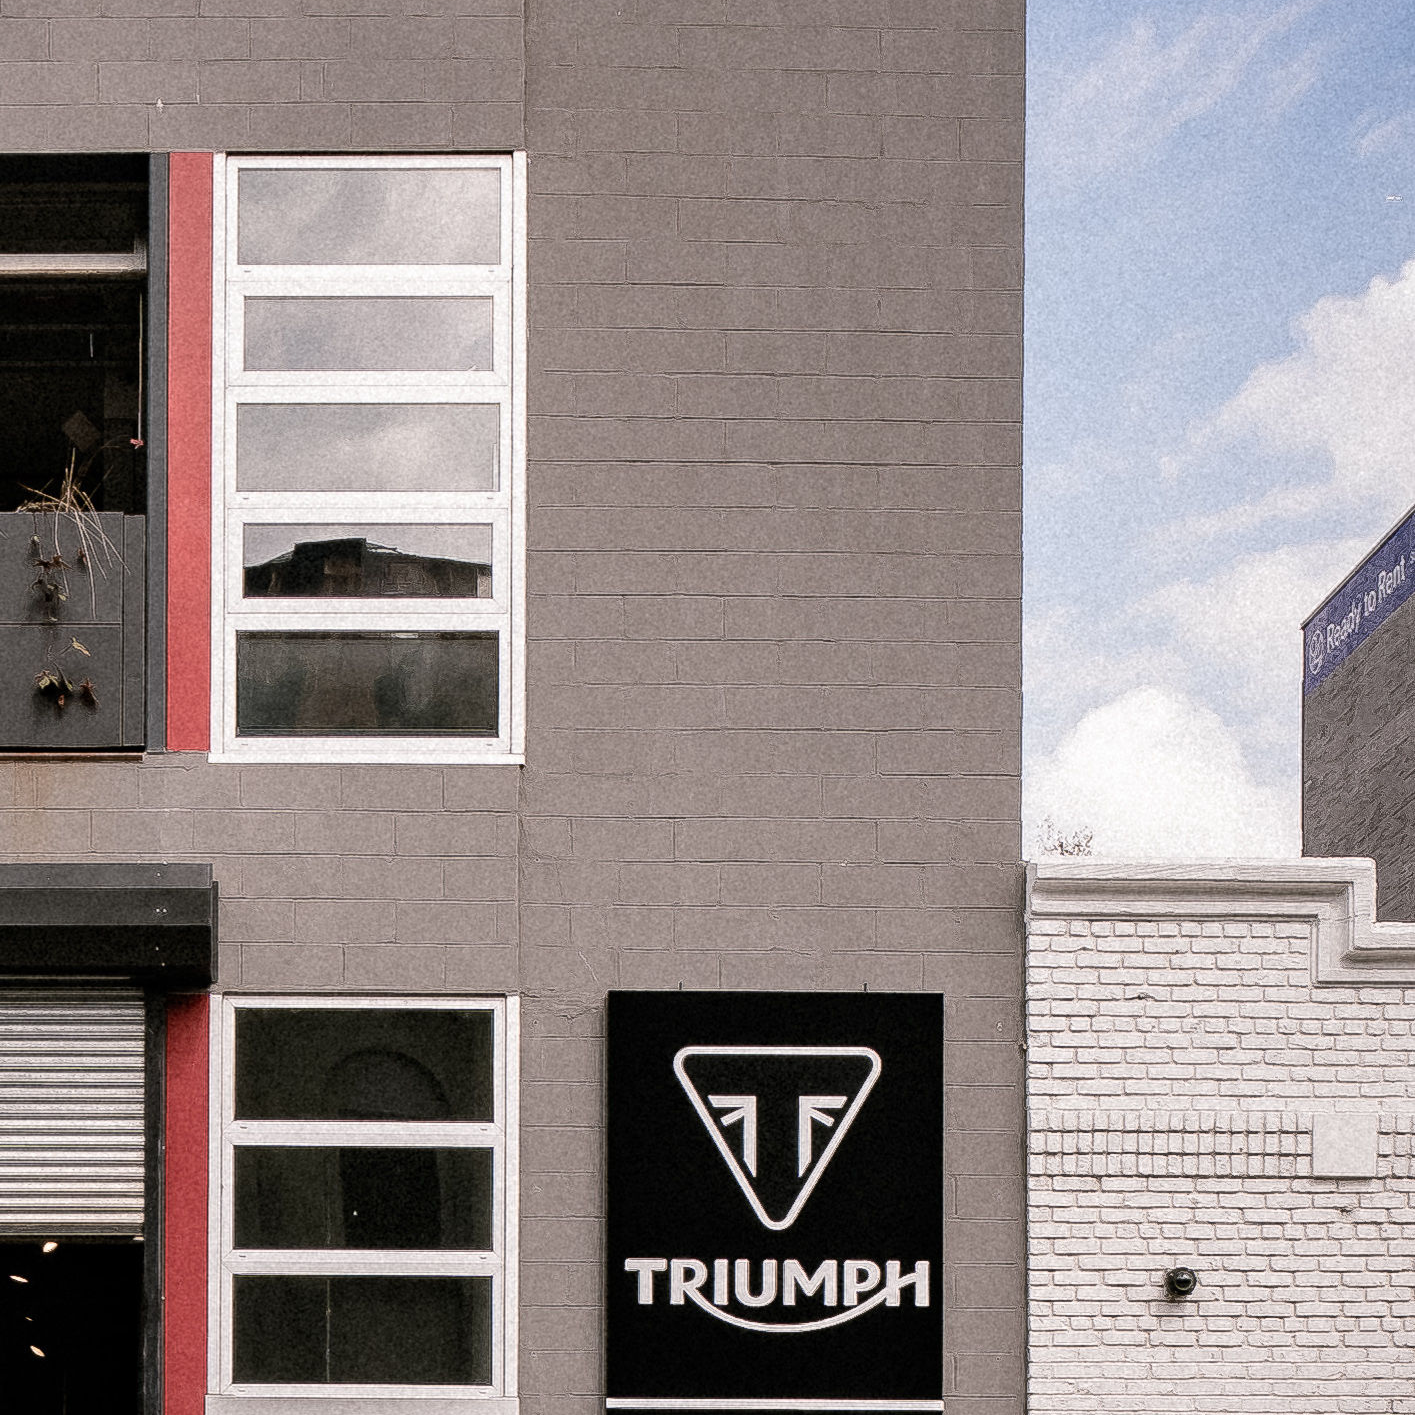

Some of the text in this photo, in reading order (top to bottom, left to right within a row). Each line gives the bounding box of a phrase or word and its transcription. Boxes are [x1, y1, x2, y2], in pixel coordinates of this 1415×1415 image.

[1327, 554, 1406, 654] Ready to Rent
[624, 1258, 930, 1333] TRIUMPH
